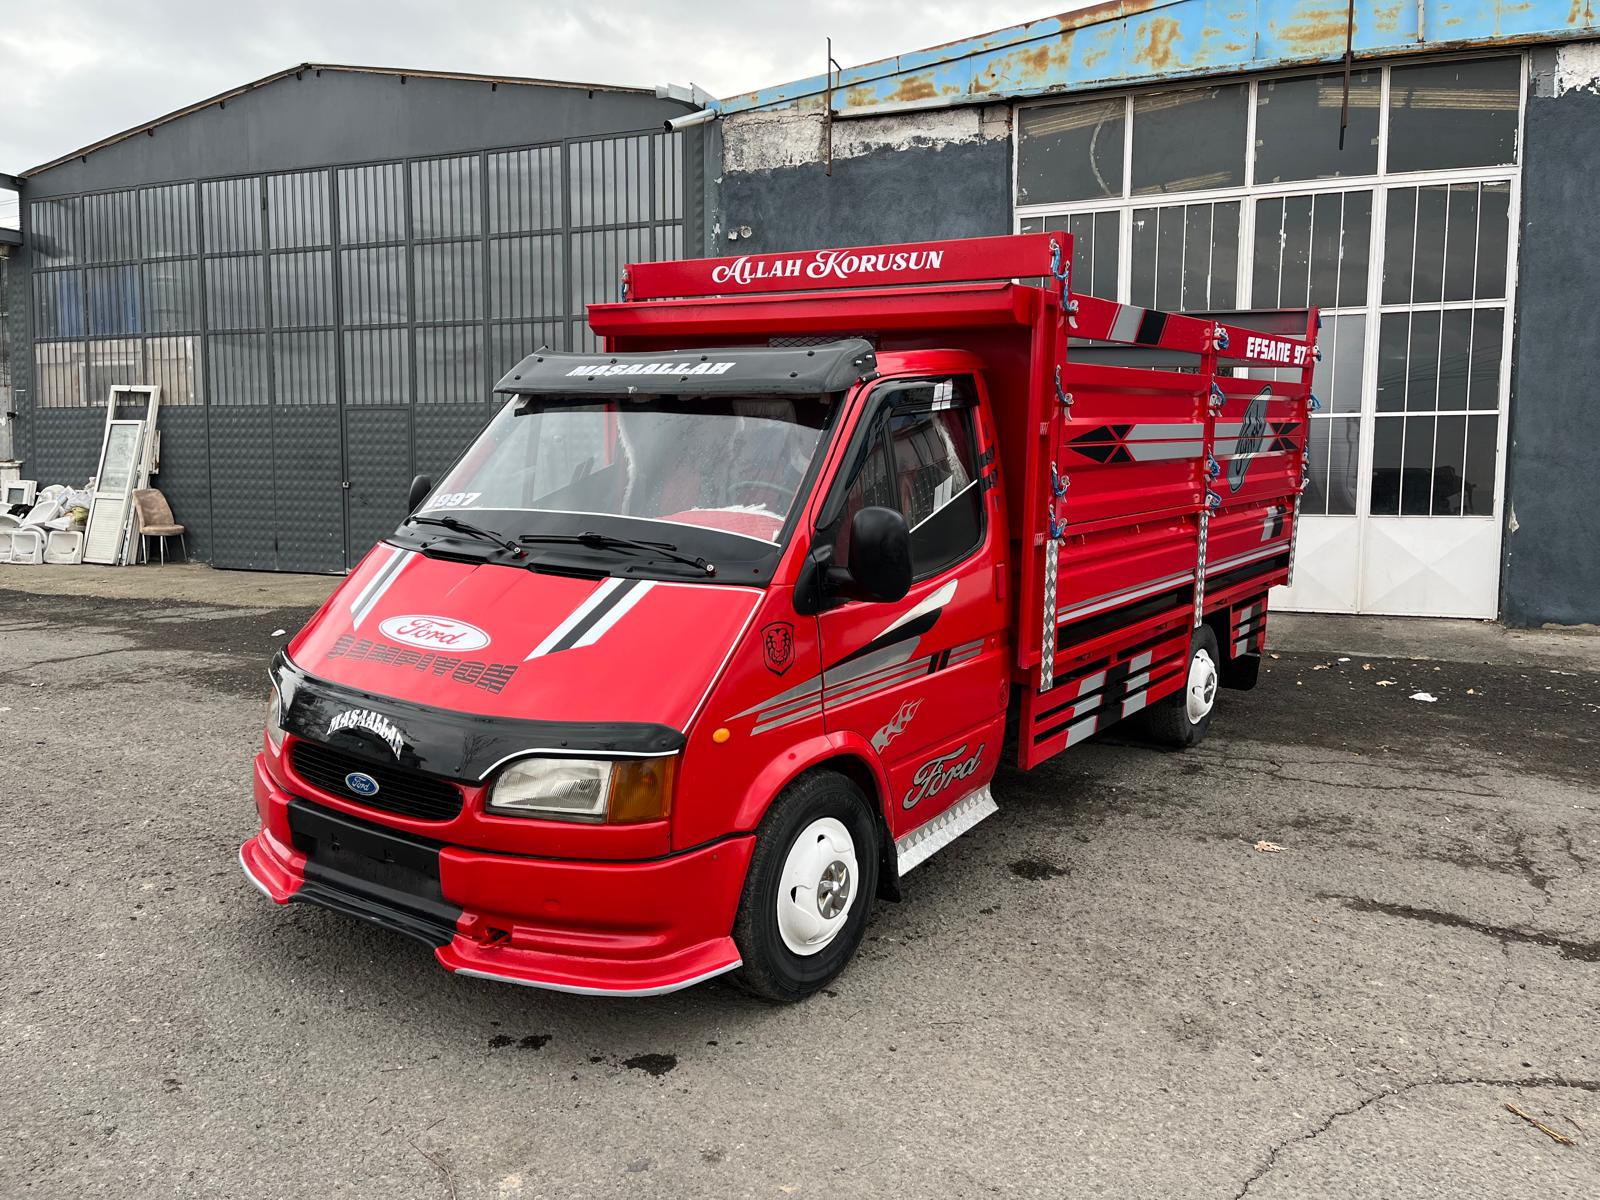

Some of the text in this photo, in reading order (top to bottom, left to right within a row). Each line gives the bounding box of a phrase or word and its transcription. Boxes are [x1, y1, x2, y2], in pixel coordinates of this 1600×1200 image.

[711, 250, 943, 285] ALLAH KORUSUN
[1246, 336, 1307, 365] EFSANE 97
[424, 492, 481, 508] 1997
[396, 618, 467, 645] Ford
[352, 776, 371, 791] Ford
[902, 743, 985, 811] Ford
